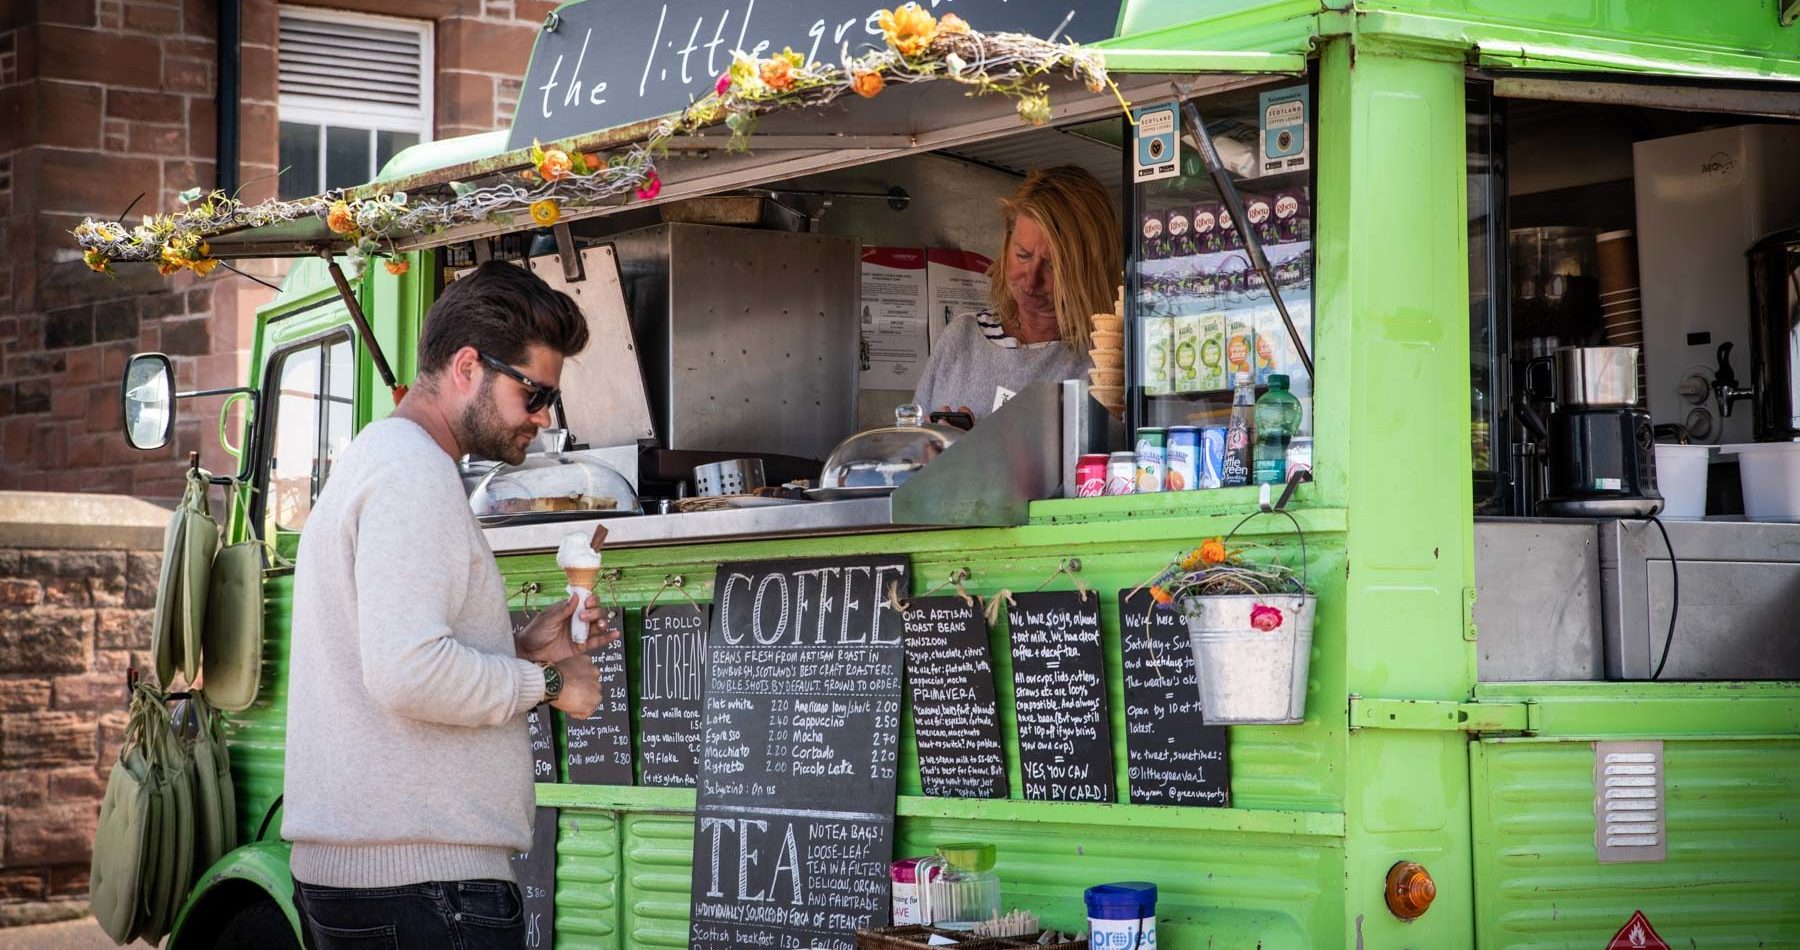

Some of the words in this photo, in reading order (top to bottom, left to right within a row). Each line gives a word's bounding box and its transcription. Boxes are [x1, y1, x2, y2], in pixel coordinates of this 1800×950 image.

[539, 28, 607, 117] the
[639, 2, 770, 97] little
[1269, 106, 1301, 117] SCOTLAND
[1141, 115, 1171, 126] SCOTLAND
[722, 565, 904, 645] COFFEE
[902, 609, 926, 621] OUR
[930, 608, 973, 620] ARTISAN
[1010, 612, 1024, 626] We
[1026, 611, 1045, 625] have
[1156, 613, 1174, 626] here
[645, 617, 660, 631] DI
[665, 616, 701, 630] ROLLO
[905, 623, 934, 633] ROAST
[937, 622, 966, 633] BEANS
[1125, 635, 1164, 659] Saturday
[641, 634, 662, 700] ICE
[666, 630, 707, 700] CREAM
[713, 650, 741, 664] BEANS
[744, 650, 774, 663] FRESH
[775, 650, 798, 664] FROM
[799, 650, 834, 663] ARTISAN
[837, 649, 866, 662] ROAST
[1125, 657, 1141, 669] and
[1184, 658, 1195, 668] to
[712, 665, 755, 679] EDINBURGH,
[755, 664, 797, 678] SCOTLAND'S
[800, 664, 818, 677] BEST
[846, 664, 894, 676] ROASTERS.
[711, 678, 743, 693] DOUBLE
[744, 679, 769, 692] SHOTS
[771, 679, 784, 693] BY
[786, 679, 821, 692] DEFAULT.
[824, 679, 855, 693] GROUND
[857, 680, 867, 692] TO
[869, 677, 901, 691] ORDER.
[914, 687, 976, 701] PRIMAVERA
[641, 706, 659, 719] Small
[662, 707, 682, 719] vanilla
[683, 710, 700, 719] cone
[707, 697, 726, 710] Flat
[727, 697, 754, 710] white
[795, 699, 829, 714] Americano
[876, 700, 898, 713] 2.00
[1127, 705, 1149, 719] Open
[1154, 704, 1165, 720] by
[1169, 702, 1178, 714] 10
[1180, 701, 1191, 713] at
[706, 712, 732, 725] Latte
[792, 715, 845, 730] Cappuccino
[875, 715, 898, 728] 2.50
[1129, 722, 1155, 734] latest.
[568, 740, 588, 749] mocha
[662, 732, 684, 743] vanilla
[685, 734, 701, 743] cone
[706, 728, 741, 745] Espresso
[768, 729, 788, 741] 2.00
[793, 729, 823, 743] Mocha
[585, 752, 605, 766] mocha
[656, 752, 679, 764] flake
[704, 742, 750, 759] Macchiato
[792, 745, 834, 760] Cortado
[1130, 750, 1142, 760] We
[1144, 749, 1173, 763] tweet,
[1173, 748, 1222, 761] sometimes:
[535, 759, 552, 776] 50p
[704, 759, 744, 774] Ristretto
[793, 761, 825, 777] Piccolo
[1024, 761, 1046, 780] YES,
[1047, 764, 1065, 779] YOU
[1068, 763, 1089, 779] CAN
[663, 774, 684, 786] gluten
[1026, 783, 1046, 800] PAY
[1052, 783, 1067, 800] BY
[1070, 783, 1107, 801] CARD!
[809, 822, 824, 840] NO
[825, 824, 848, 840] TEA
[851, 824, 884, 846] BAGS!
[807, 843, 870, 860] LOOSE-LEAF
[701, 817, 804, 905] TEA
[806, 860, 826, 875] TEA
[830, 860, 839, 874] IN
[840, 861, 846, 875] A
[848, 860, 886, 878] FILTER!
[808, 876, 851, 893] DELICIOUS,
[854, 879, 889, 896] ORGANIC
[808, 891, 826, 907] AND
[829, 893, 882, 911] FAIRTRADE.
[776, 906, 788, 925] BY
[813, 911, 825, 928] OF
[829, 914, 872, 930] ETEAKET
[691, 923, 729, 942] Scottish
[736, 929, 774, 946] breakfast
[780, 933, 800, 948] 1.30
[1093, 926, 1155, 950] projec
